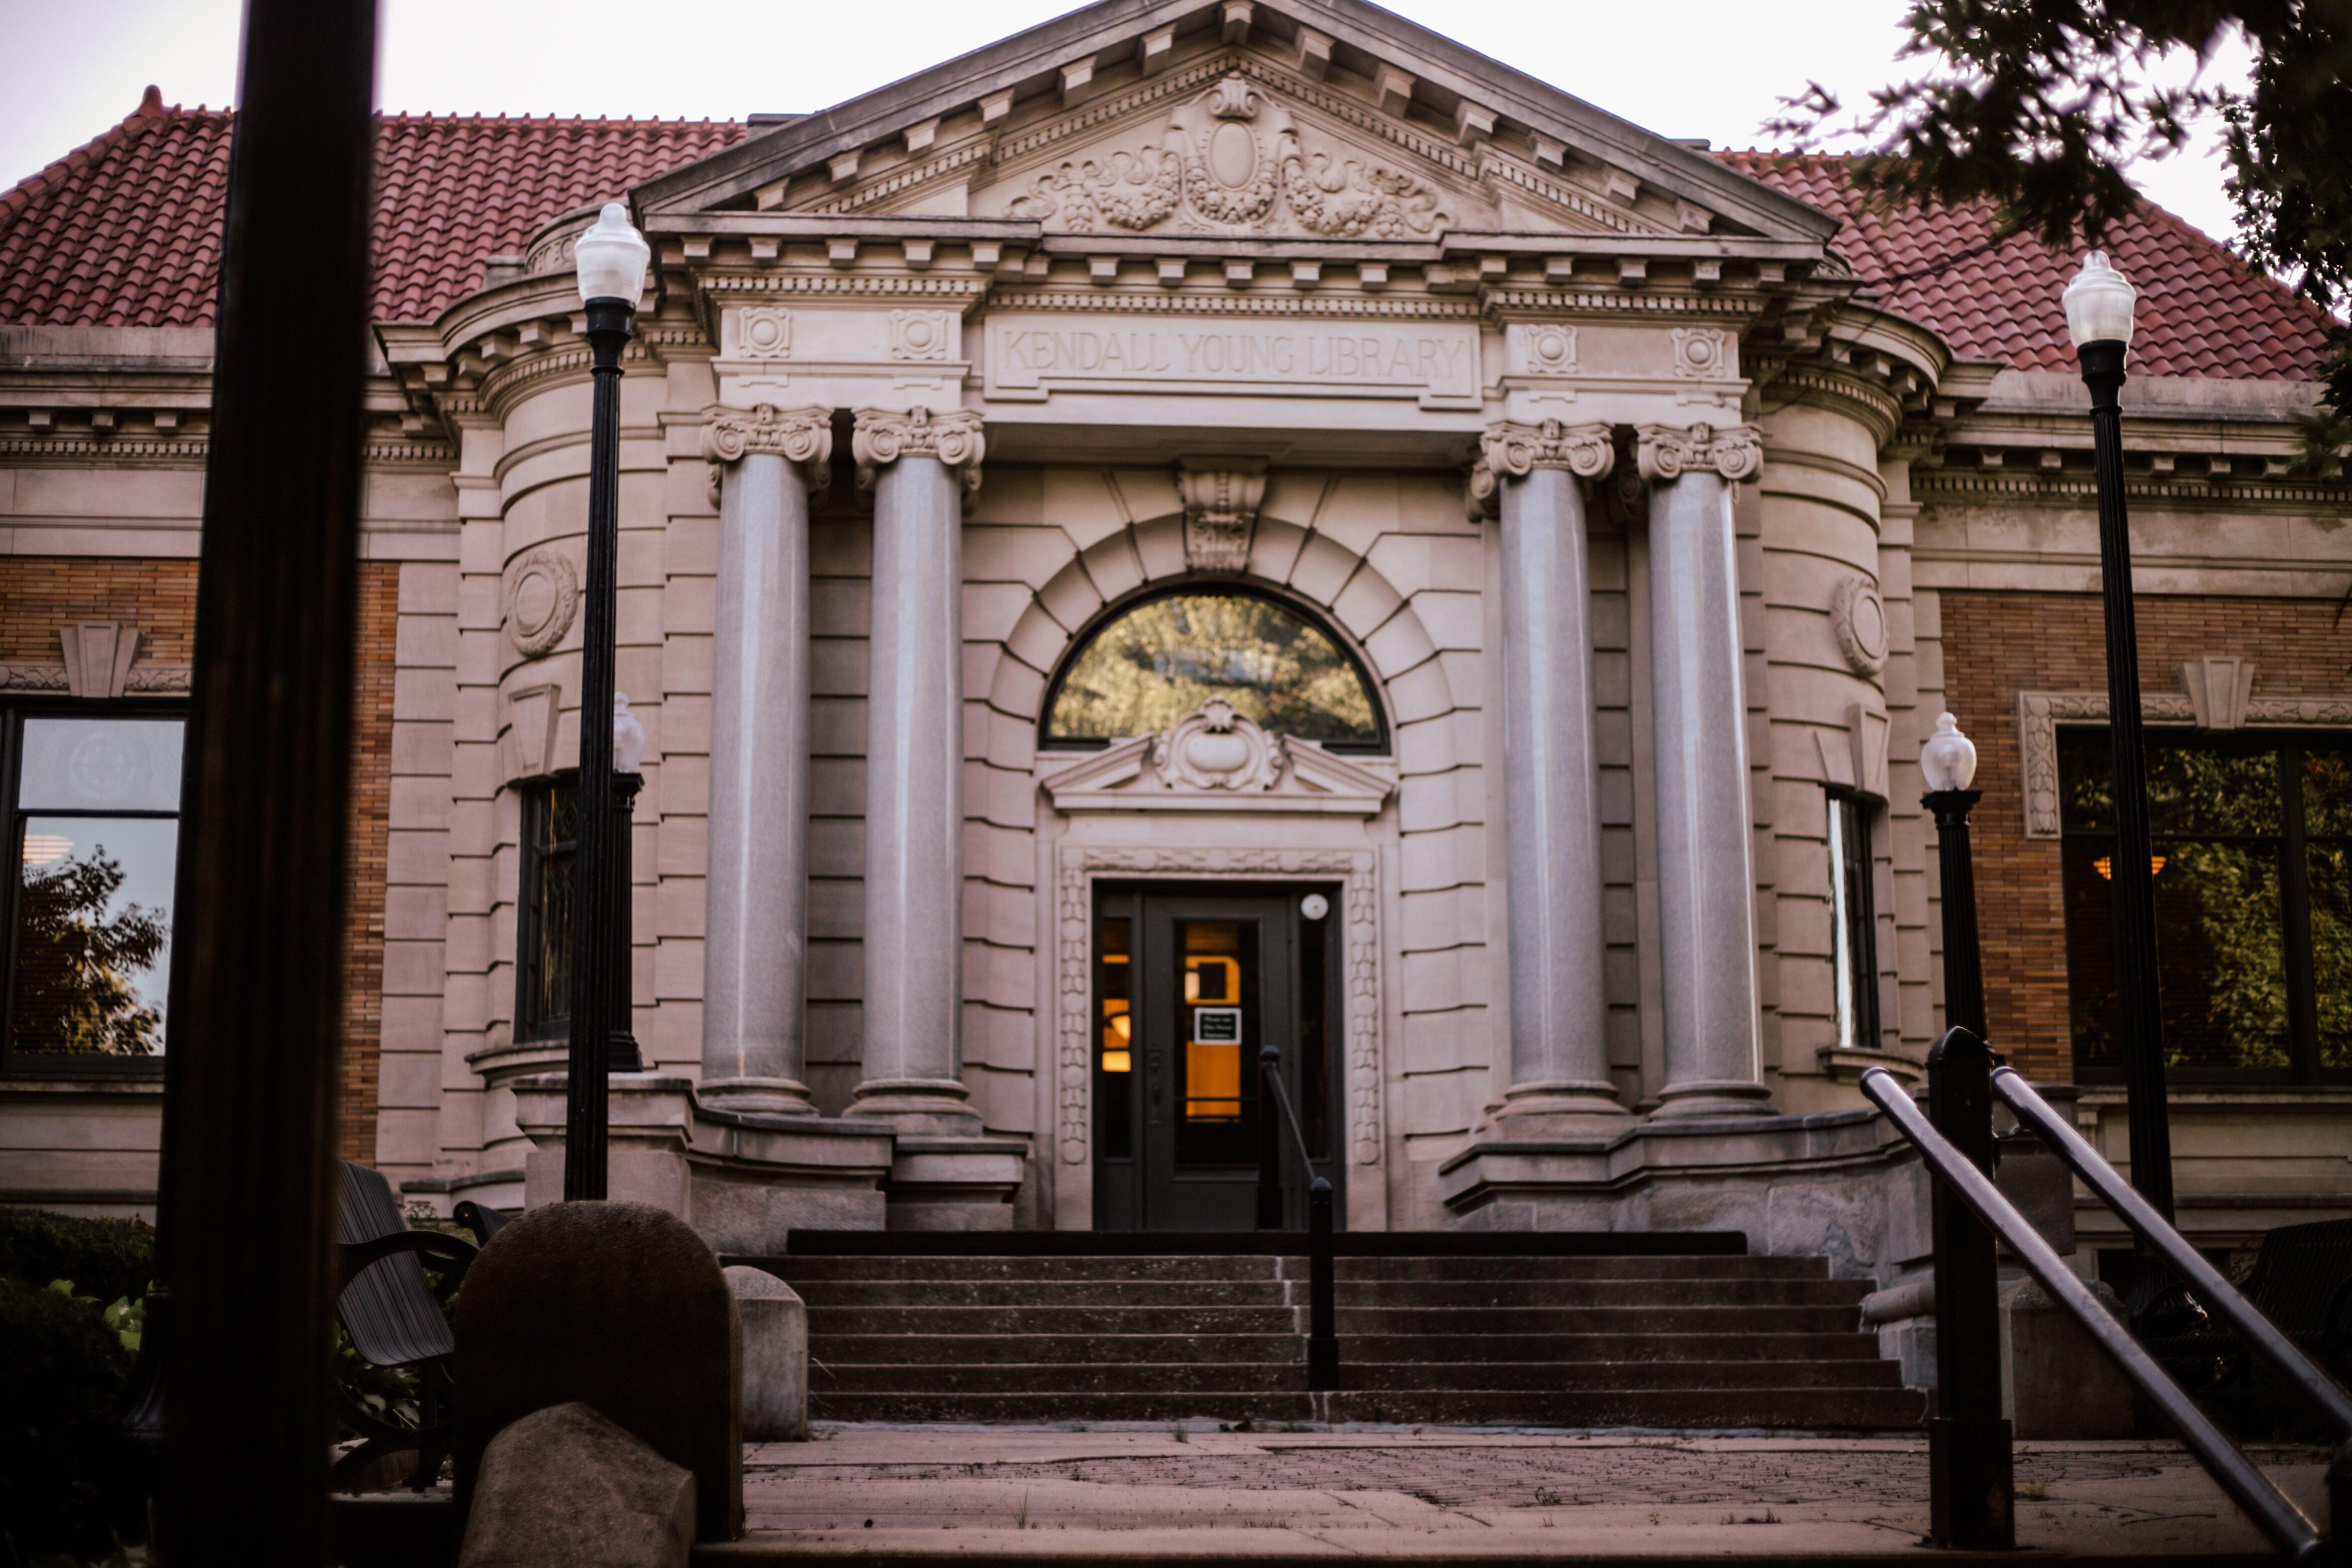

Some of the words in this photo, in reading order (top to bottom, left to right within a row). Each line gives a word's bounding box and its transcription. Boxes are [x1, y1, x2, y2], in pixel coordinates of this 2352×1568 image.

[1005, 331, 1170, 371] KENDALL
[1178, 334, 1296, 373] YOUNG
[1308, 337, 1465, 378] LIBRARY
